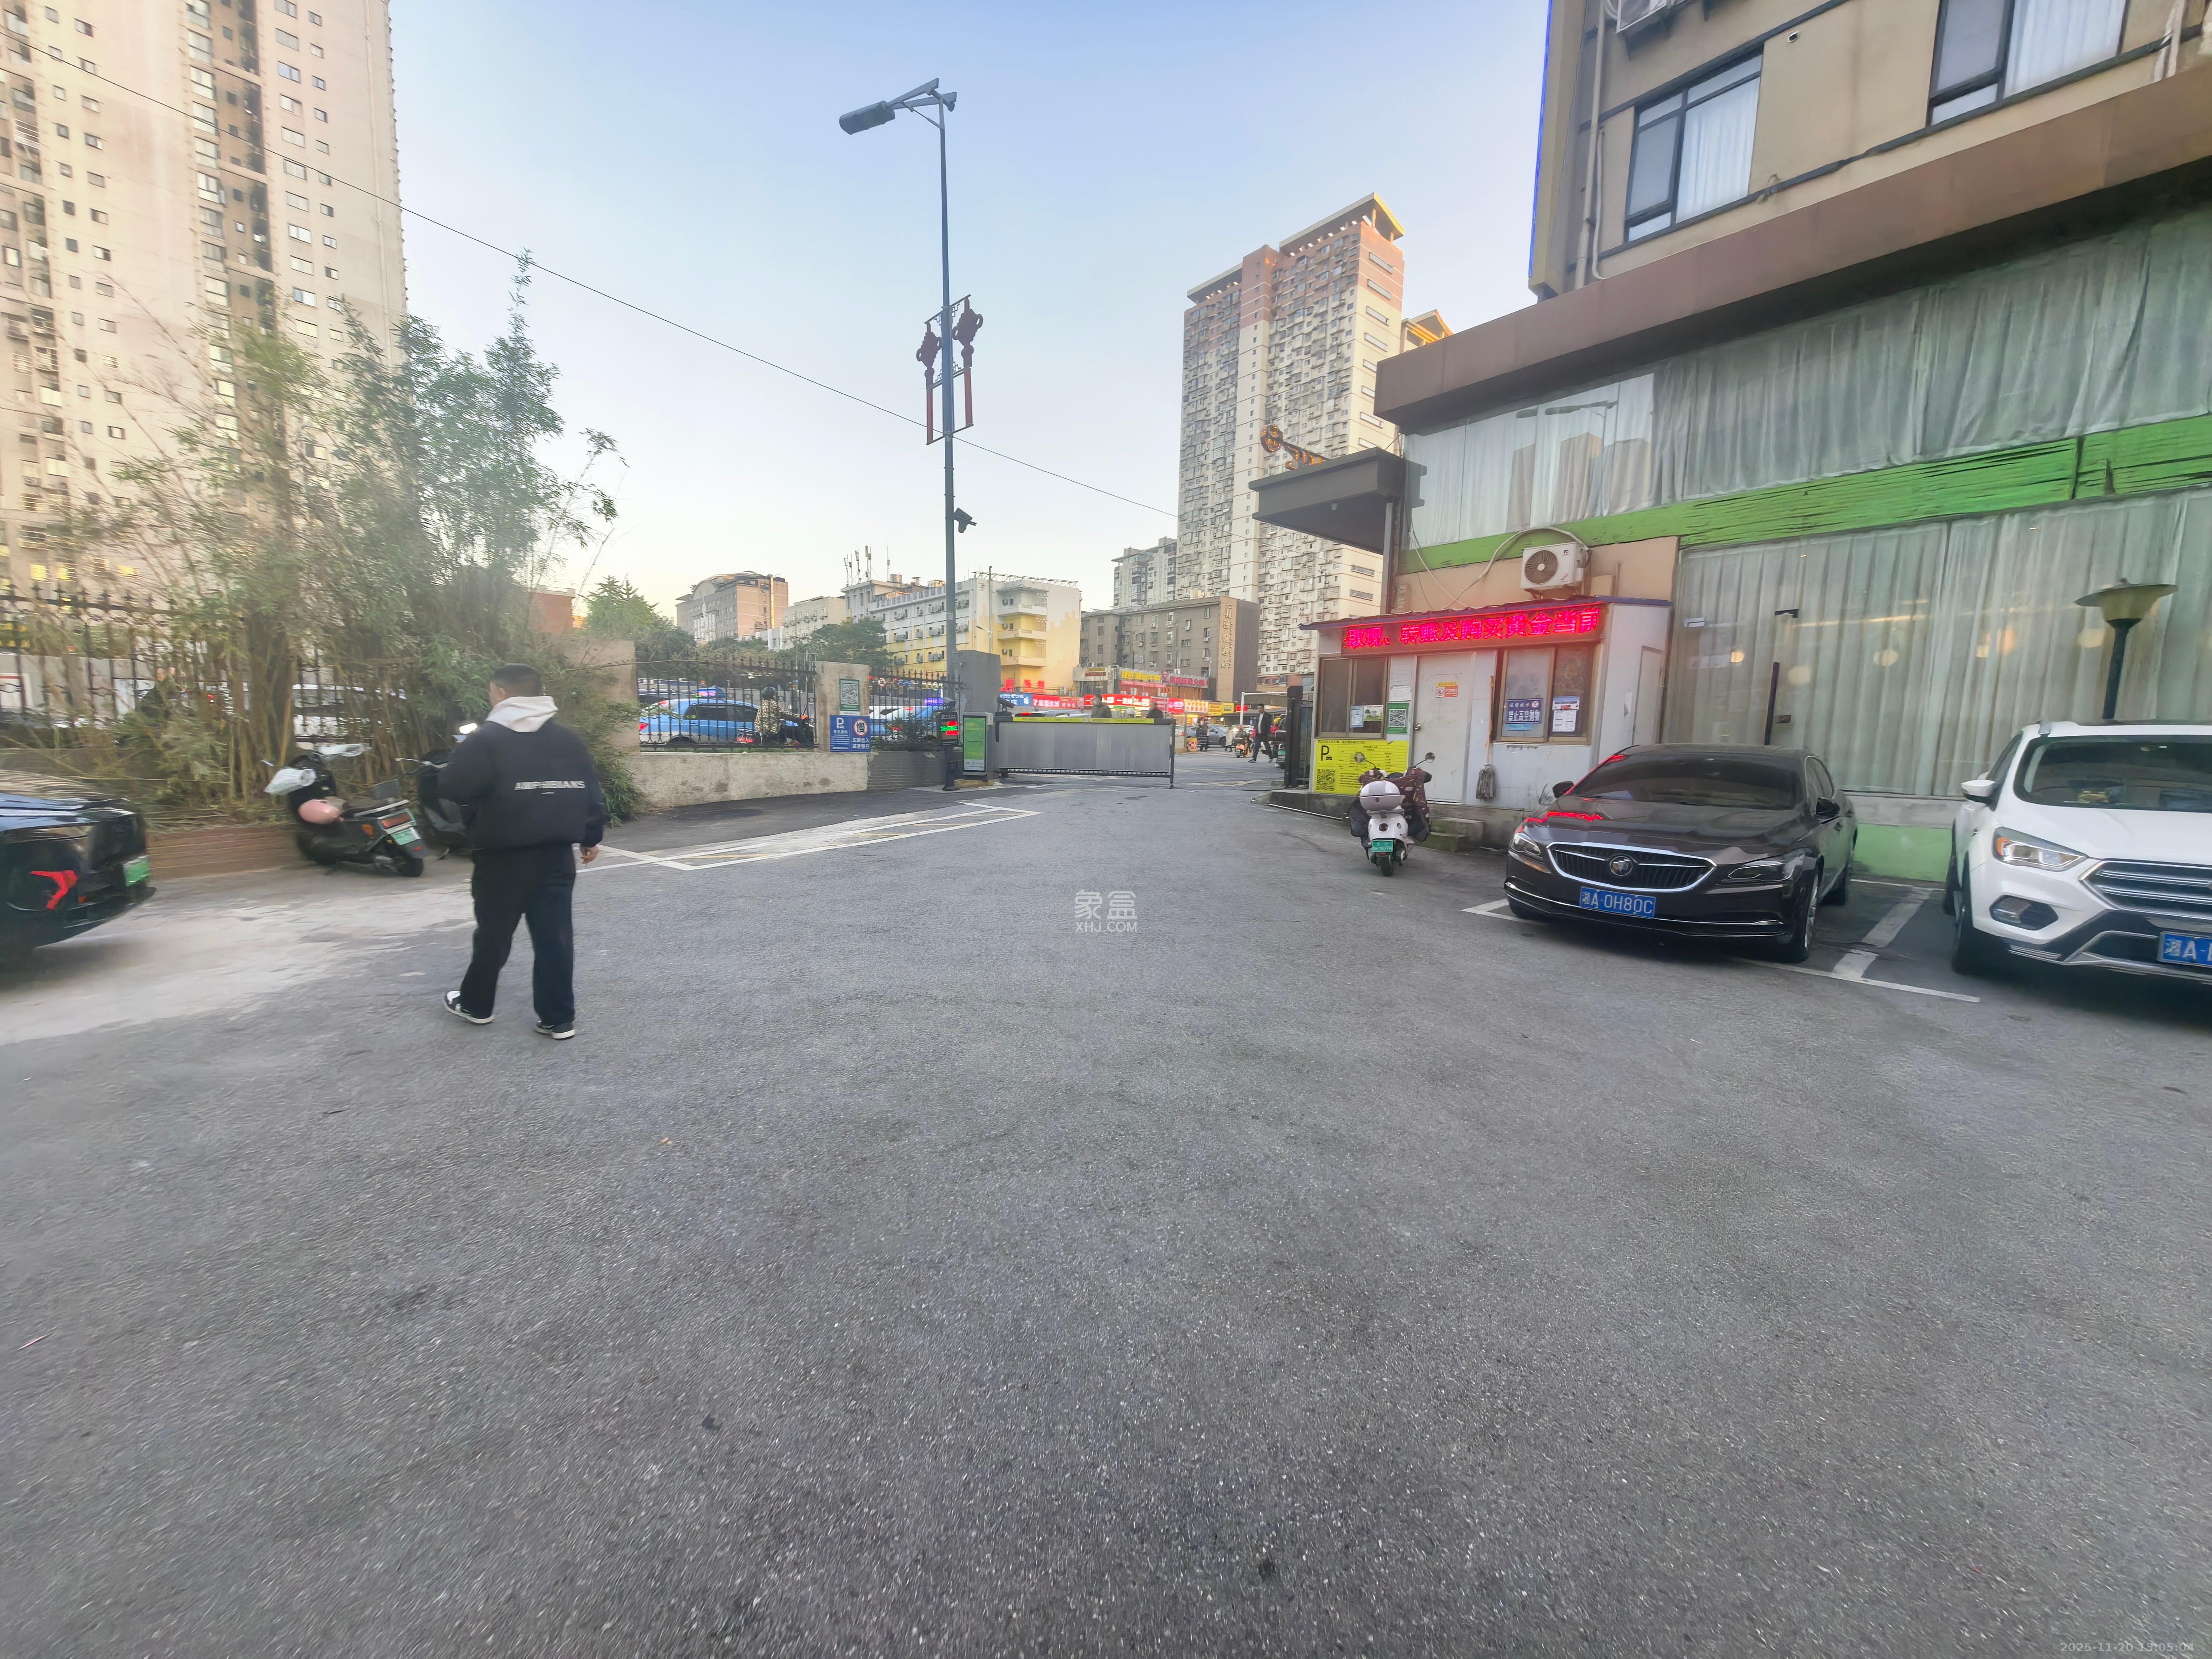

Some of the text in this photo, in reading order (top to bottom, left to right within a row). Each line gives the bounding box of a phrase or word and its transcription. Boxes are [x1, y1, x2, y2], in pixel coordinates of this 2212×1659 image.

[1508, 710, 1540, 722] 禁止高空抛物
[836, 717, 844, 729] P
[856, 722, 865, 733] 慢
[1321, 745, 1330, 761] P
